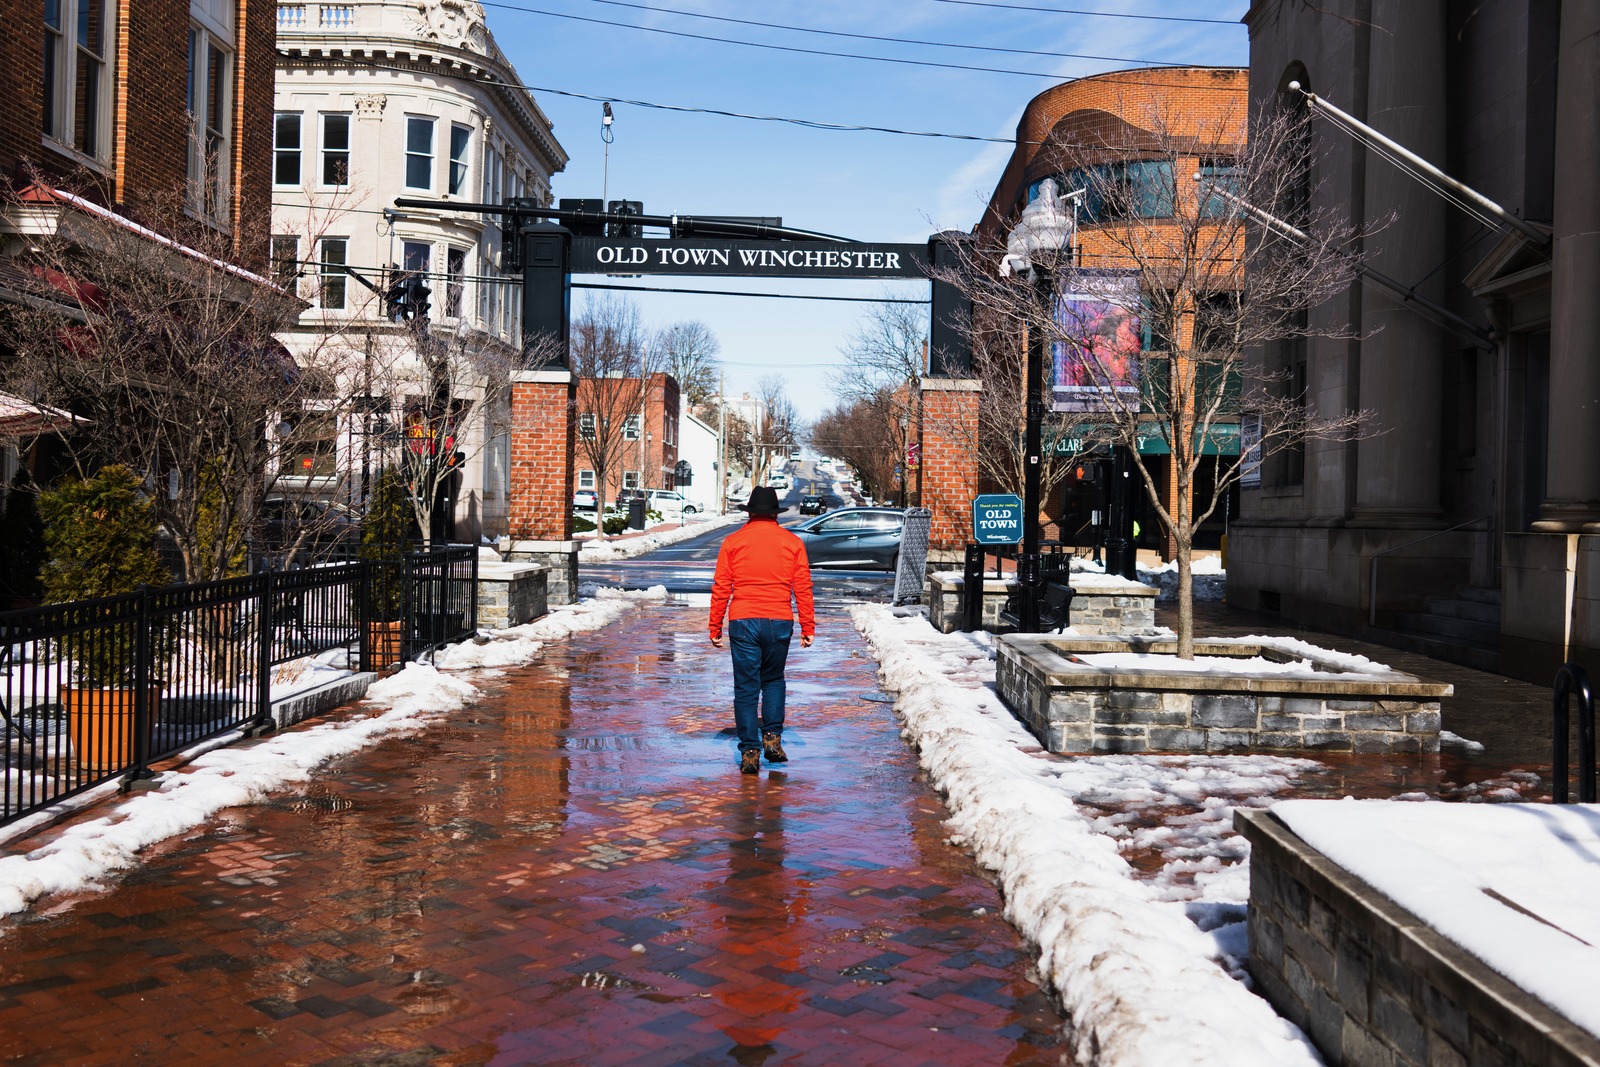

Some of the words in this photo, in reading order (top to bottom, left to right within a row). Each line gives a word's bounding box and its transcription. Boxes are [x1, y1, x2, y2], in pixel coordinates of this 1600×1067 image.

[596, 246, 648, 264] OLD
[656, 247, 730, 266] TOWN
[738, 249, 901, 269] WINCHESTER
[985, 509, 1012, 519] OLD
[980, 520, 1017, 529] TOWN
